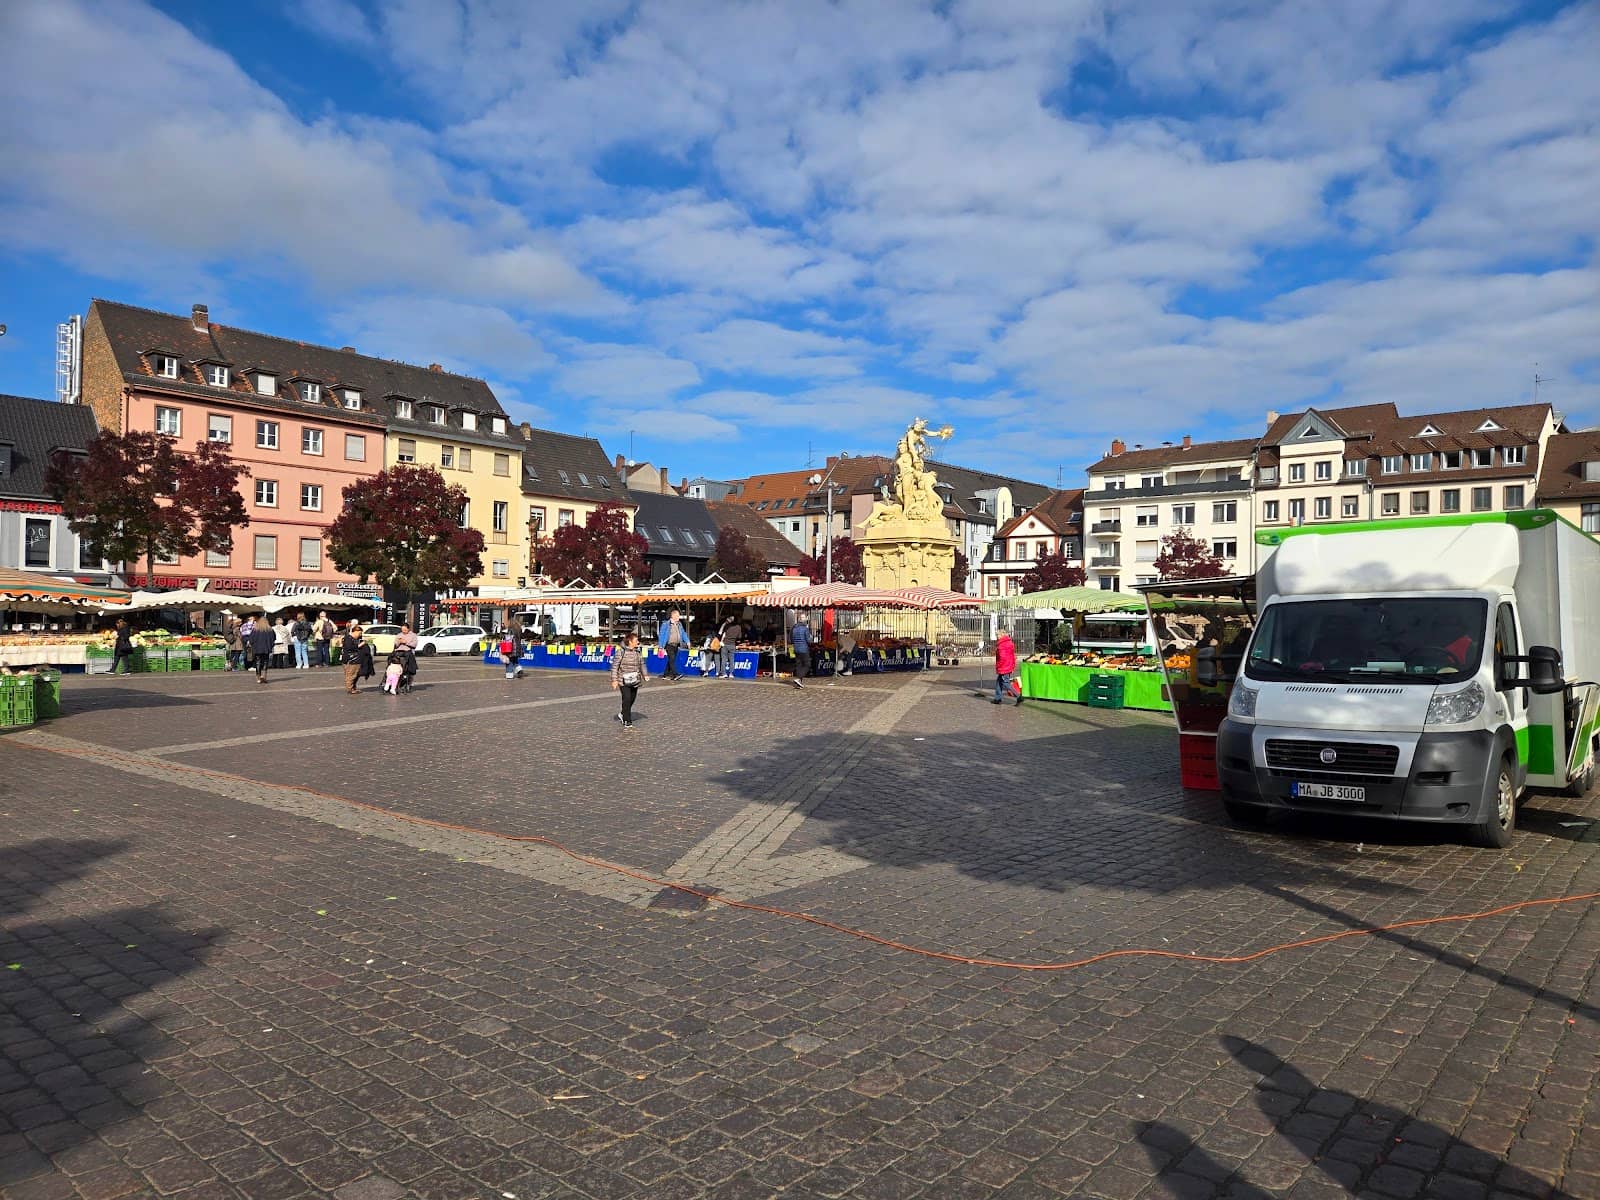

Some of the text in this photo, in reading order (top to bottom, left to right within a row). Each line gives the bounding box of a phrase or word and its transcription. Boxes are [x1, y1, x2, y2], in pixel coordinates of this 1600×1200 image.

[269, 580, 330, 596] Adana
[1299, 784, 1364, 800] MA JB 3000
